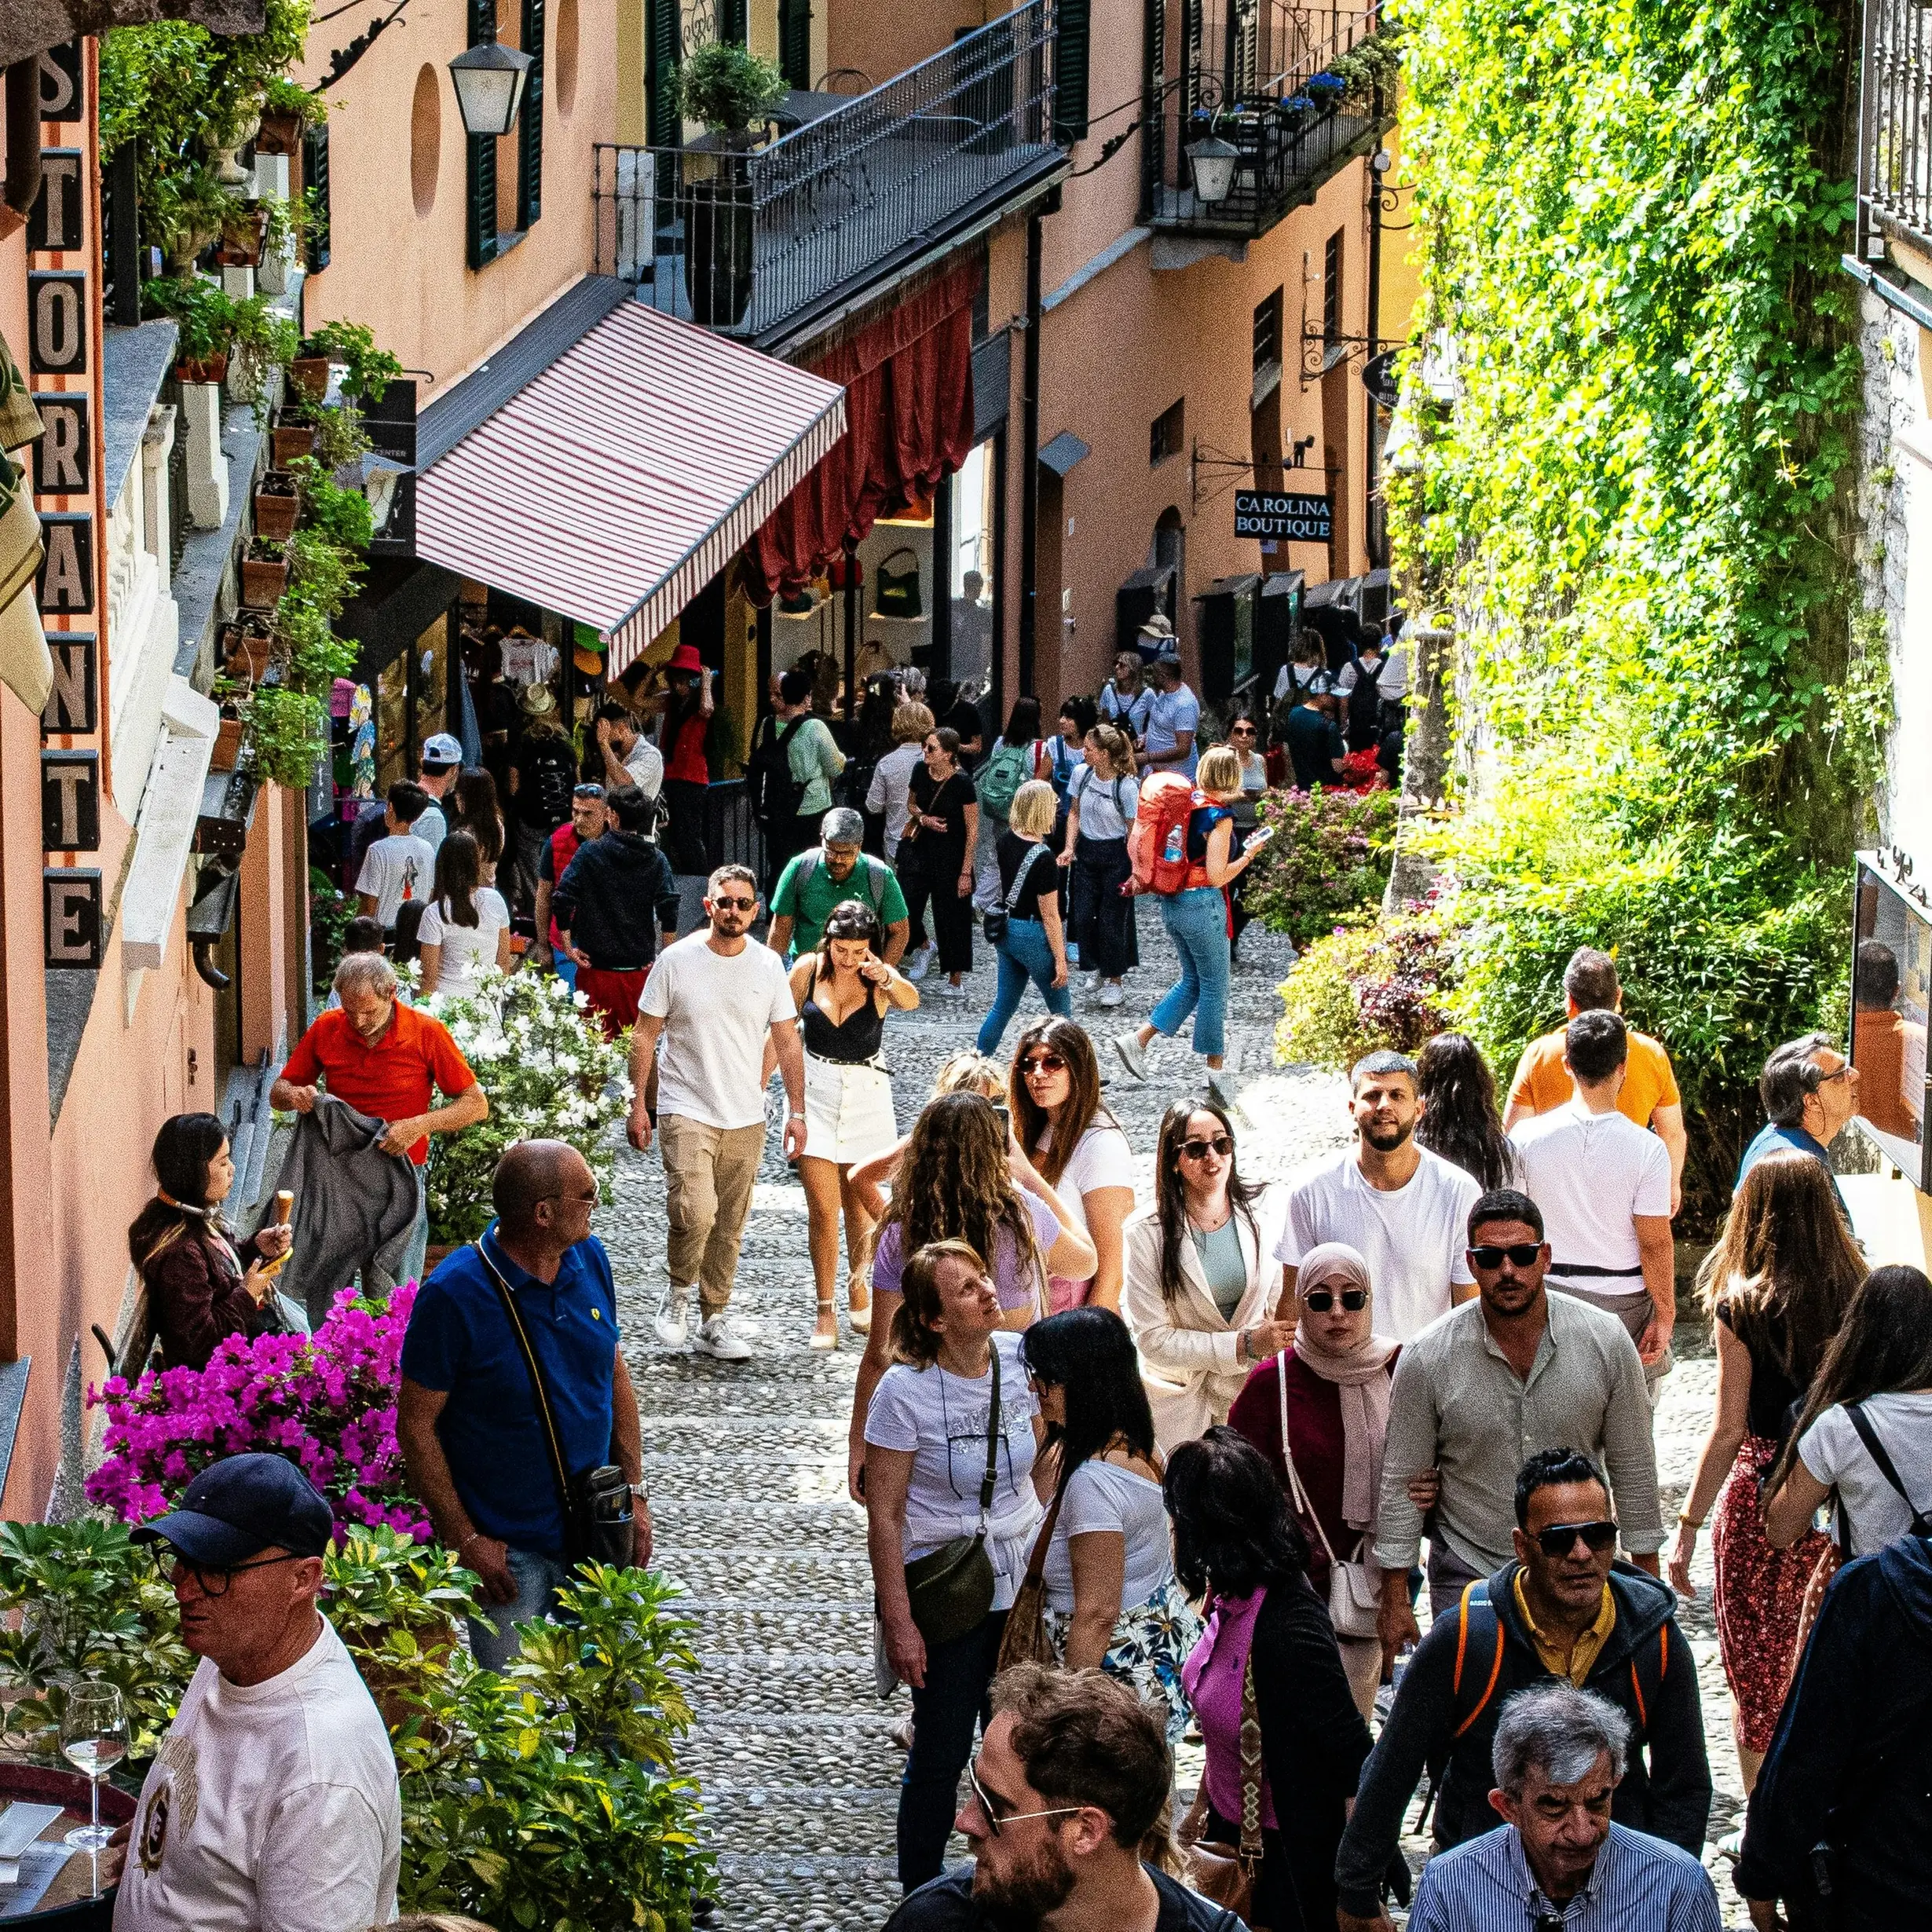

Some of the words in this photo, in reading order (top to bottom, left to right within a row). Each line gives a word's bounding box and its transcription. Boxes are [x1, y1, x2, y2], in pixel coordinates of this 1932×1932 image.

[374, 448, 407, 457] CENTER
[1235, 496, 1330, 516] CAROLINA
[1236, 516, 1330, 538] BOUTIQUE
